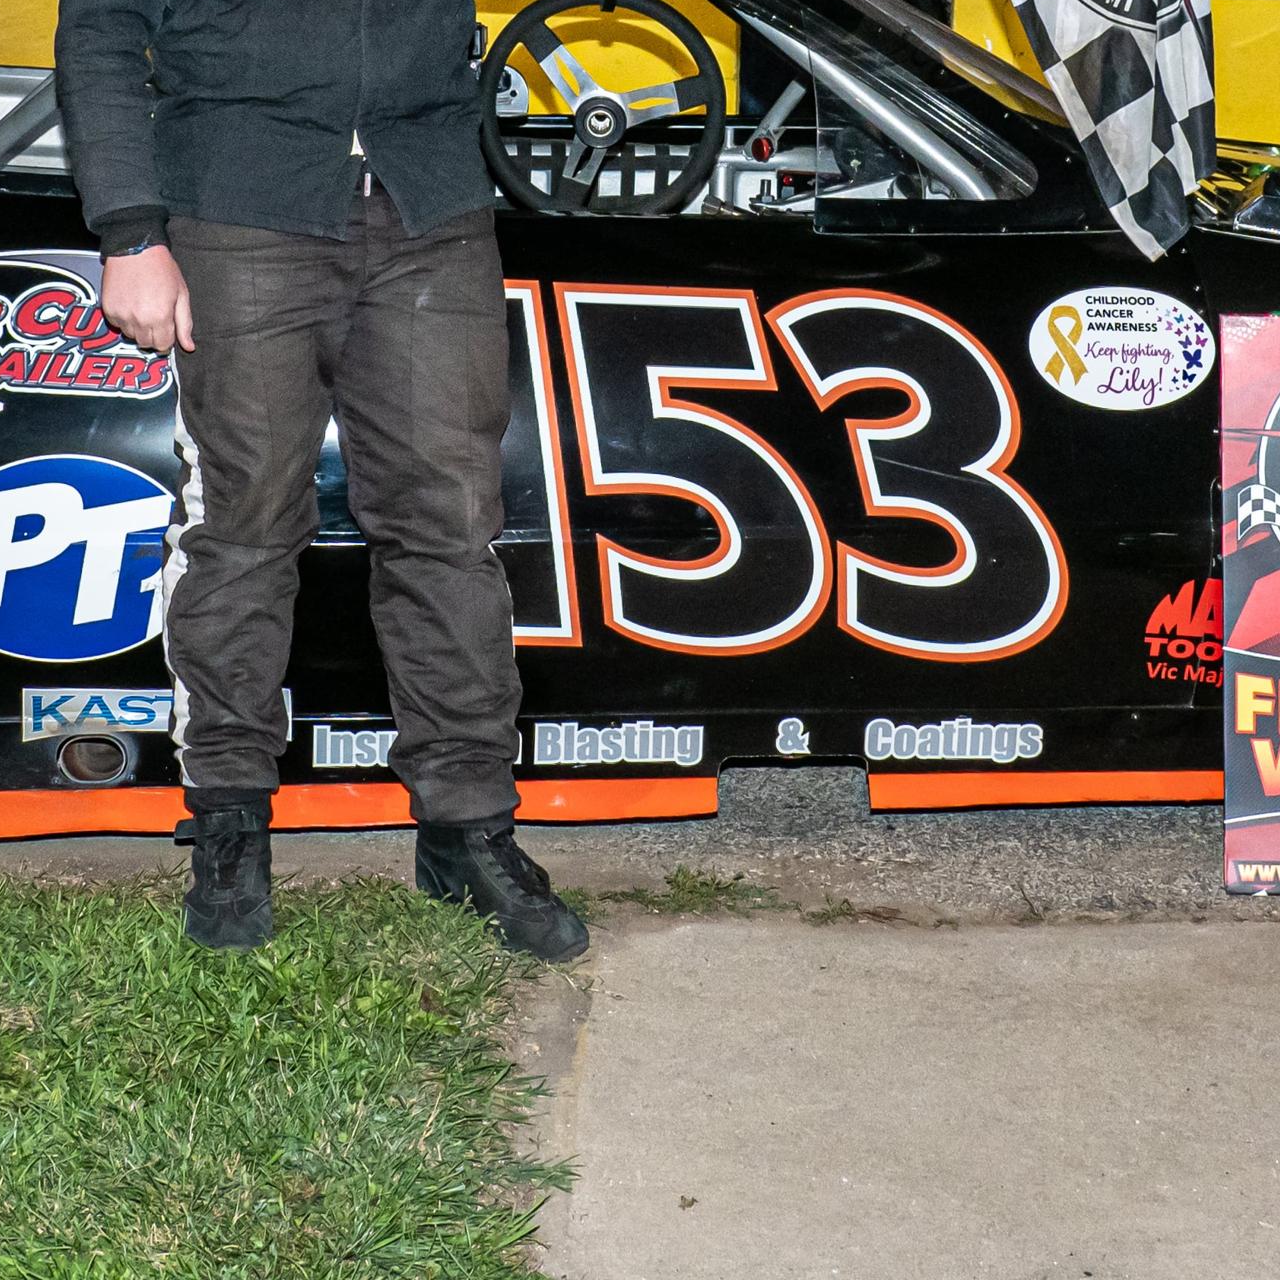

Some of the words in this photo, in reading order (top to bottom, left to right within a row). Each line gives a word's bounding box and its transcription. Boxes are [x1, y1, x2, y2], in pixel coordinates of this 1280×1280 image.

[1085, 296, 1155, 306] CHILDHOOD
[1086, 308, 1134, 319] CANCER
[1087, 322, 1158, 332] AWARENESS
[1084, 341, 1119, 363] Keep
[1097, 366, 1163, 406] Lily!
[1145, 578, 1223, 639] MA
[1144, 637, 1223, 661] TOO
[1147, 662, 1178, 680] Vic
[534, 720, 705, 767] Blasting
[775, 717, 810, 755] &
[863, 717, 1044, 761] Coatings
